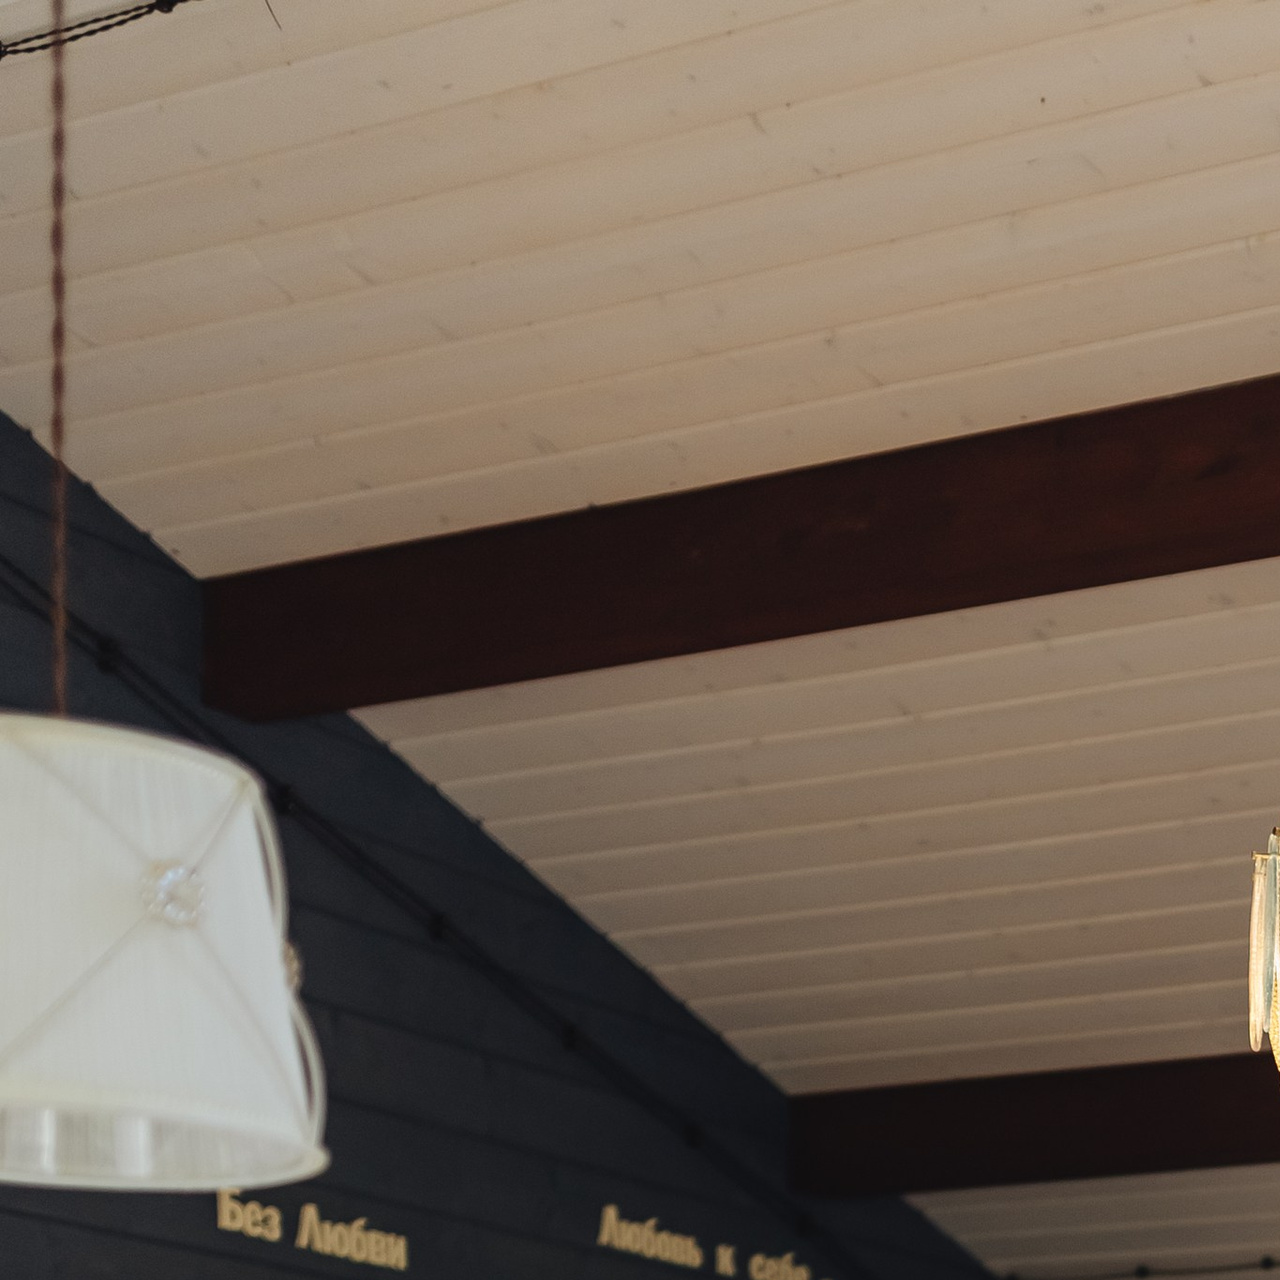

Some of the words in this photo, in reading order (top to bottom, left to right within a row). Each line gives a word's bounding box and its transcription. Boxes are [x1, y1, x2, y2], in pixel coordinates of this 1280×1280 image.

[217, 1187, 282, 1242] Без
[295, 1203, 408, 1271] Любви
[597, 1203, 704, 1268] Любовь
[715, 1243, 737, 1277] к
